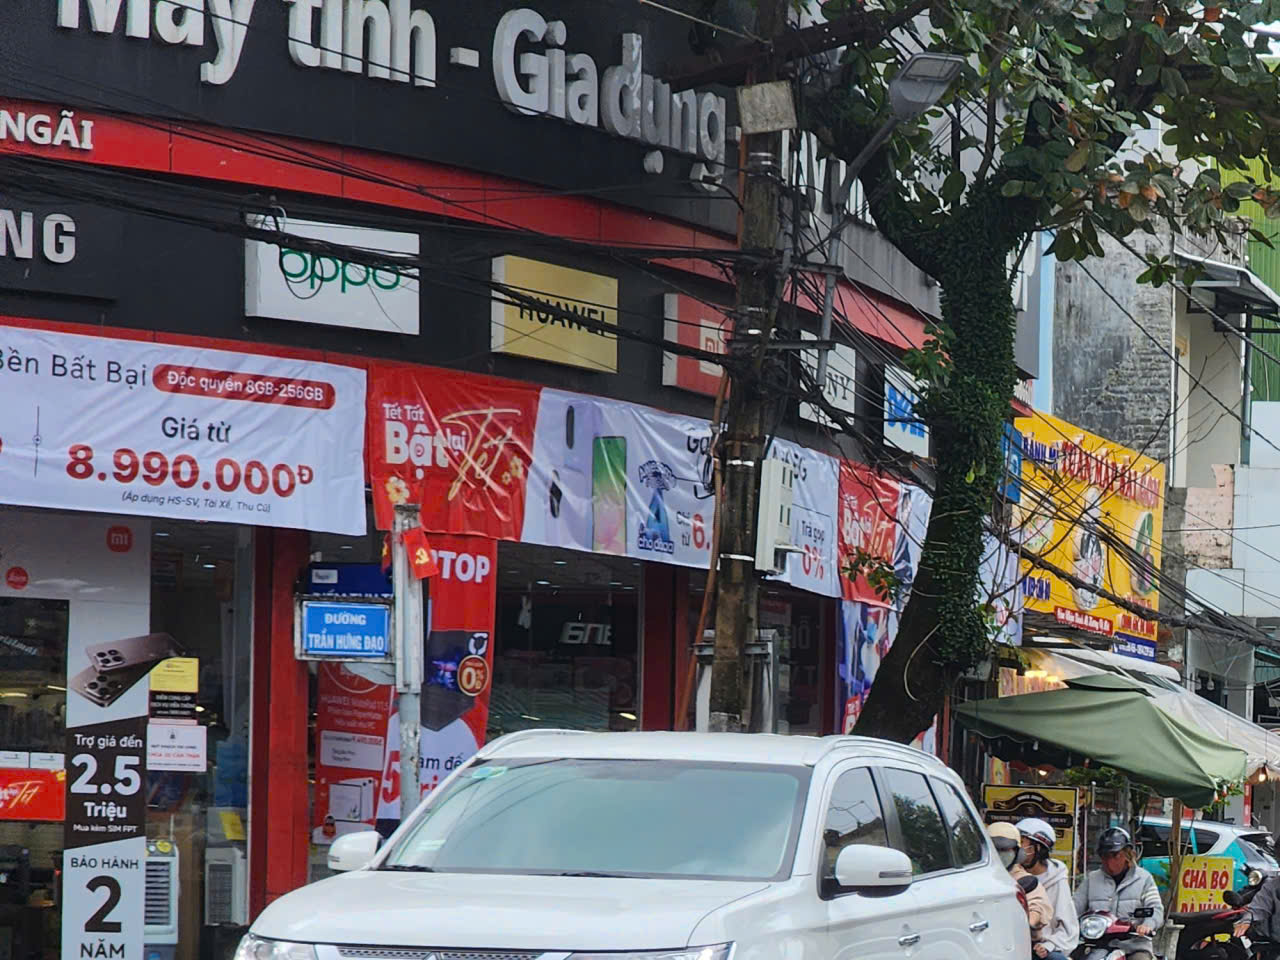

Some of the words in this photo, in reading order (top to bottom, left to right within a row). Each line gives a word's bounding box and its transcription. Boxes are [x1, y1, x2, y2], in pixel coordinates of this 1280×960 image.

[0, 346, 39, 375] ền
[51, 353, 96, 381] Bất
[106, 360, 147, 390] Bại
[167, 370, 196, 390] Độc
[199, 373, 243, 395] quyền
[246, 380, 324, 401] 8GB-256GB
[161, 416, 200, 441] Giá
[207, 422, 232, 443] từ
[74, 733, 95, 750] Trợ
[97, 734, 117, 750] giá
[119, 732, 143, 748] đến
[70, 753, 141, 796] 2.5
[83, 801, 128, 822] Triệu
[70, 855, 98, 869] BẢO
[101, 856, 139, 870] HÀNH
[84, 874, 122, 933] 2
[80, 938, 125, 959] NĂM
